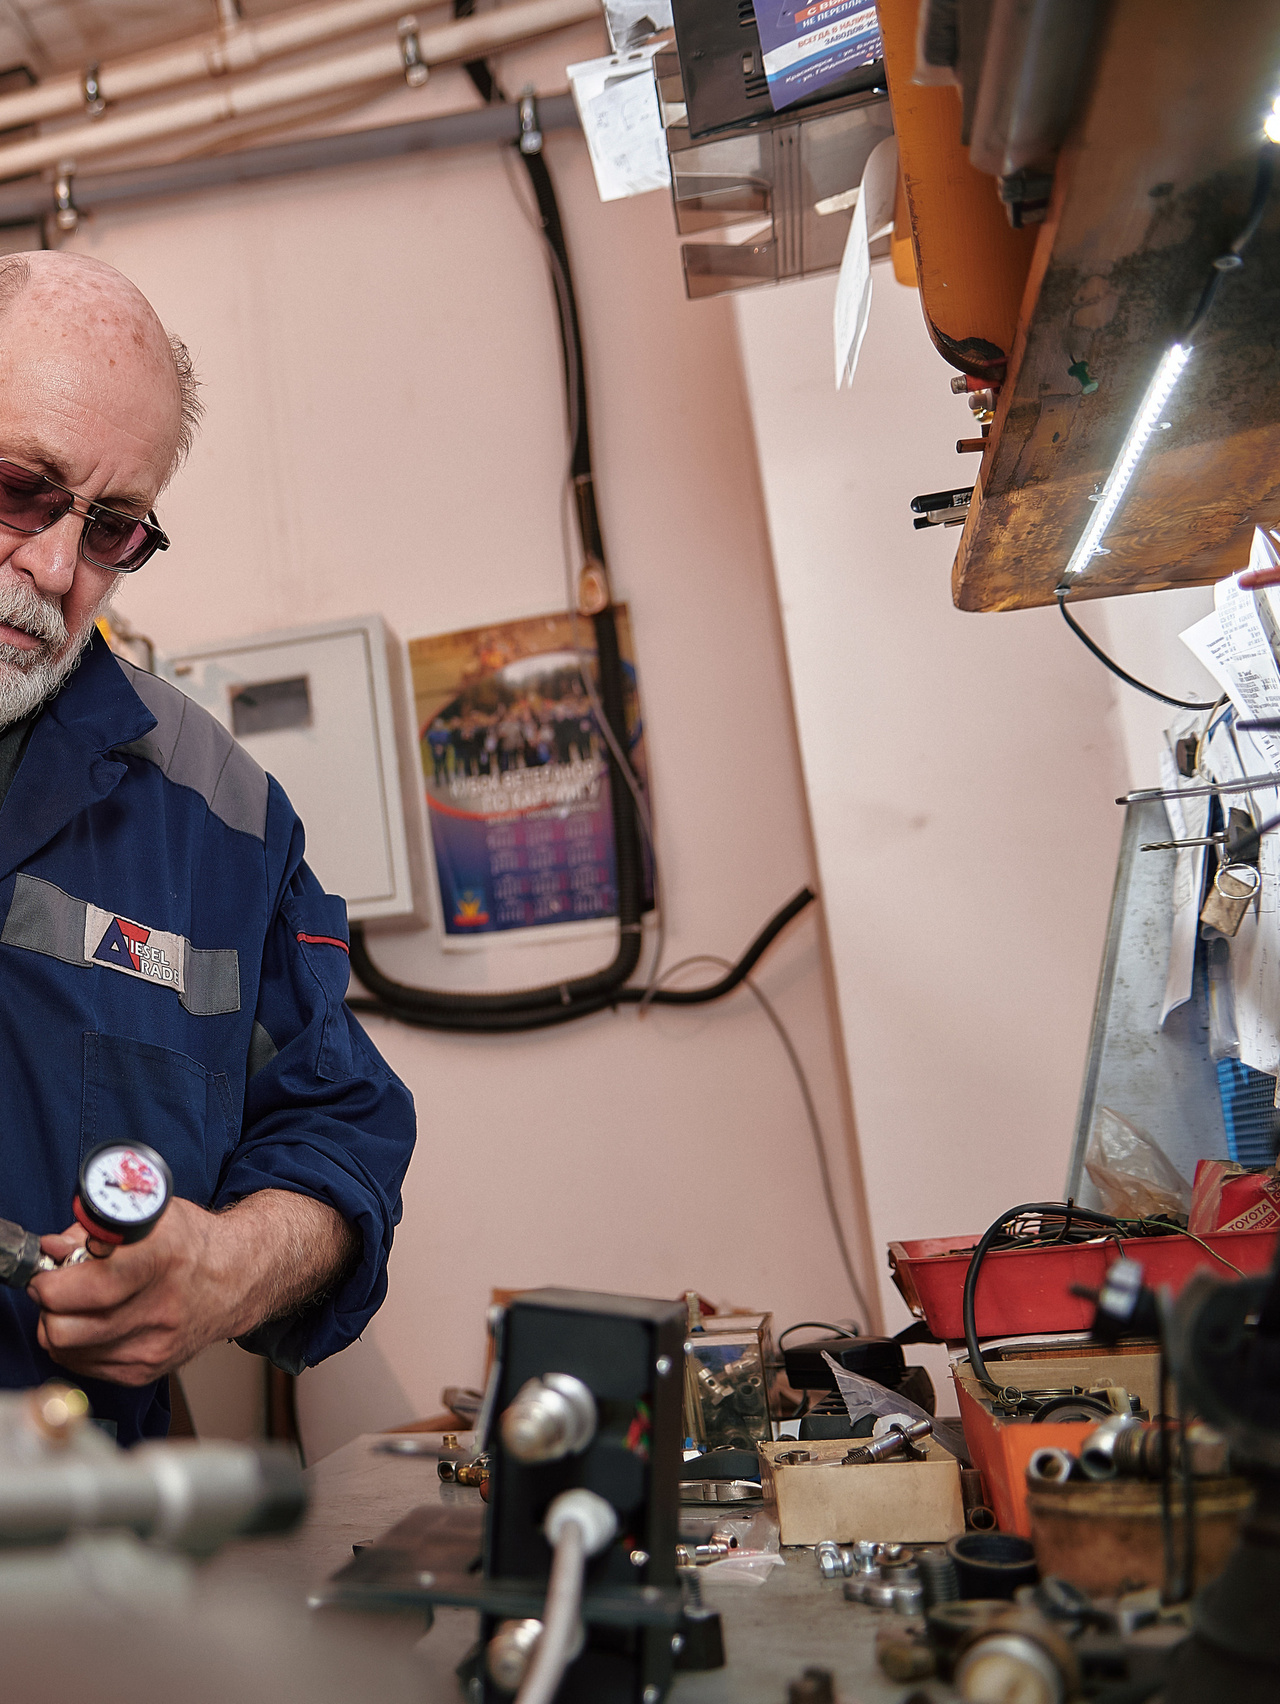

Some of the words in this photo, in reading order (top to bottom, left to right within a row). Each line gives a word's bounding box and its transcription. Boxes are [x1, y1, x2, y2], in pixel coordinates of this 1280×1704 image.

[802, 16, 816, 28] НЕ
[798, 30, 829, 48] ВСЕГДА
[1228, 1203, 1271, 1231] TOYOTA
